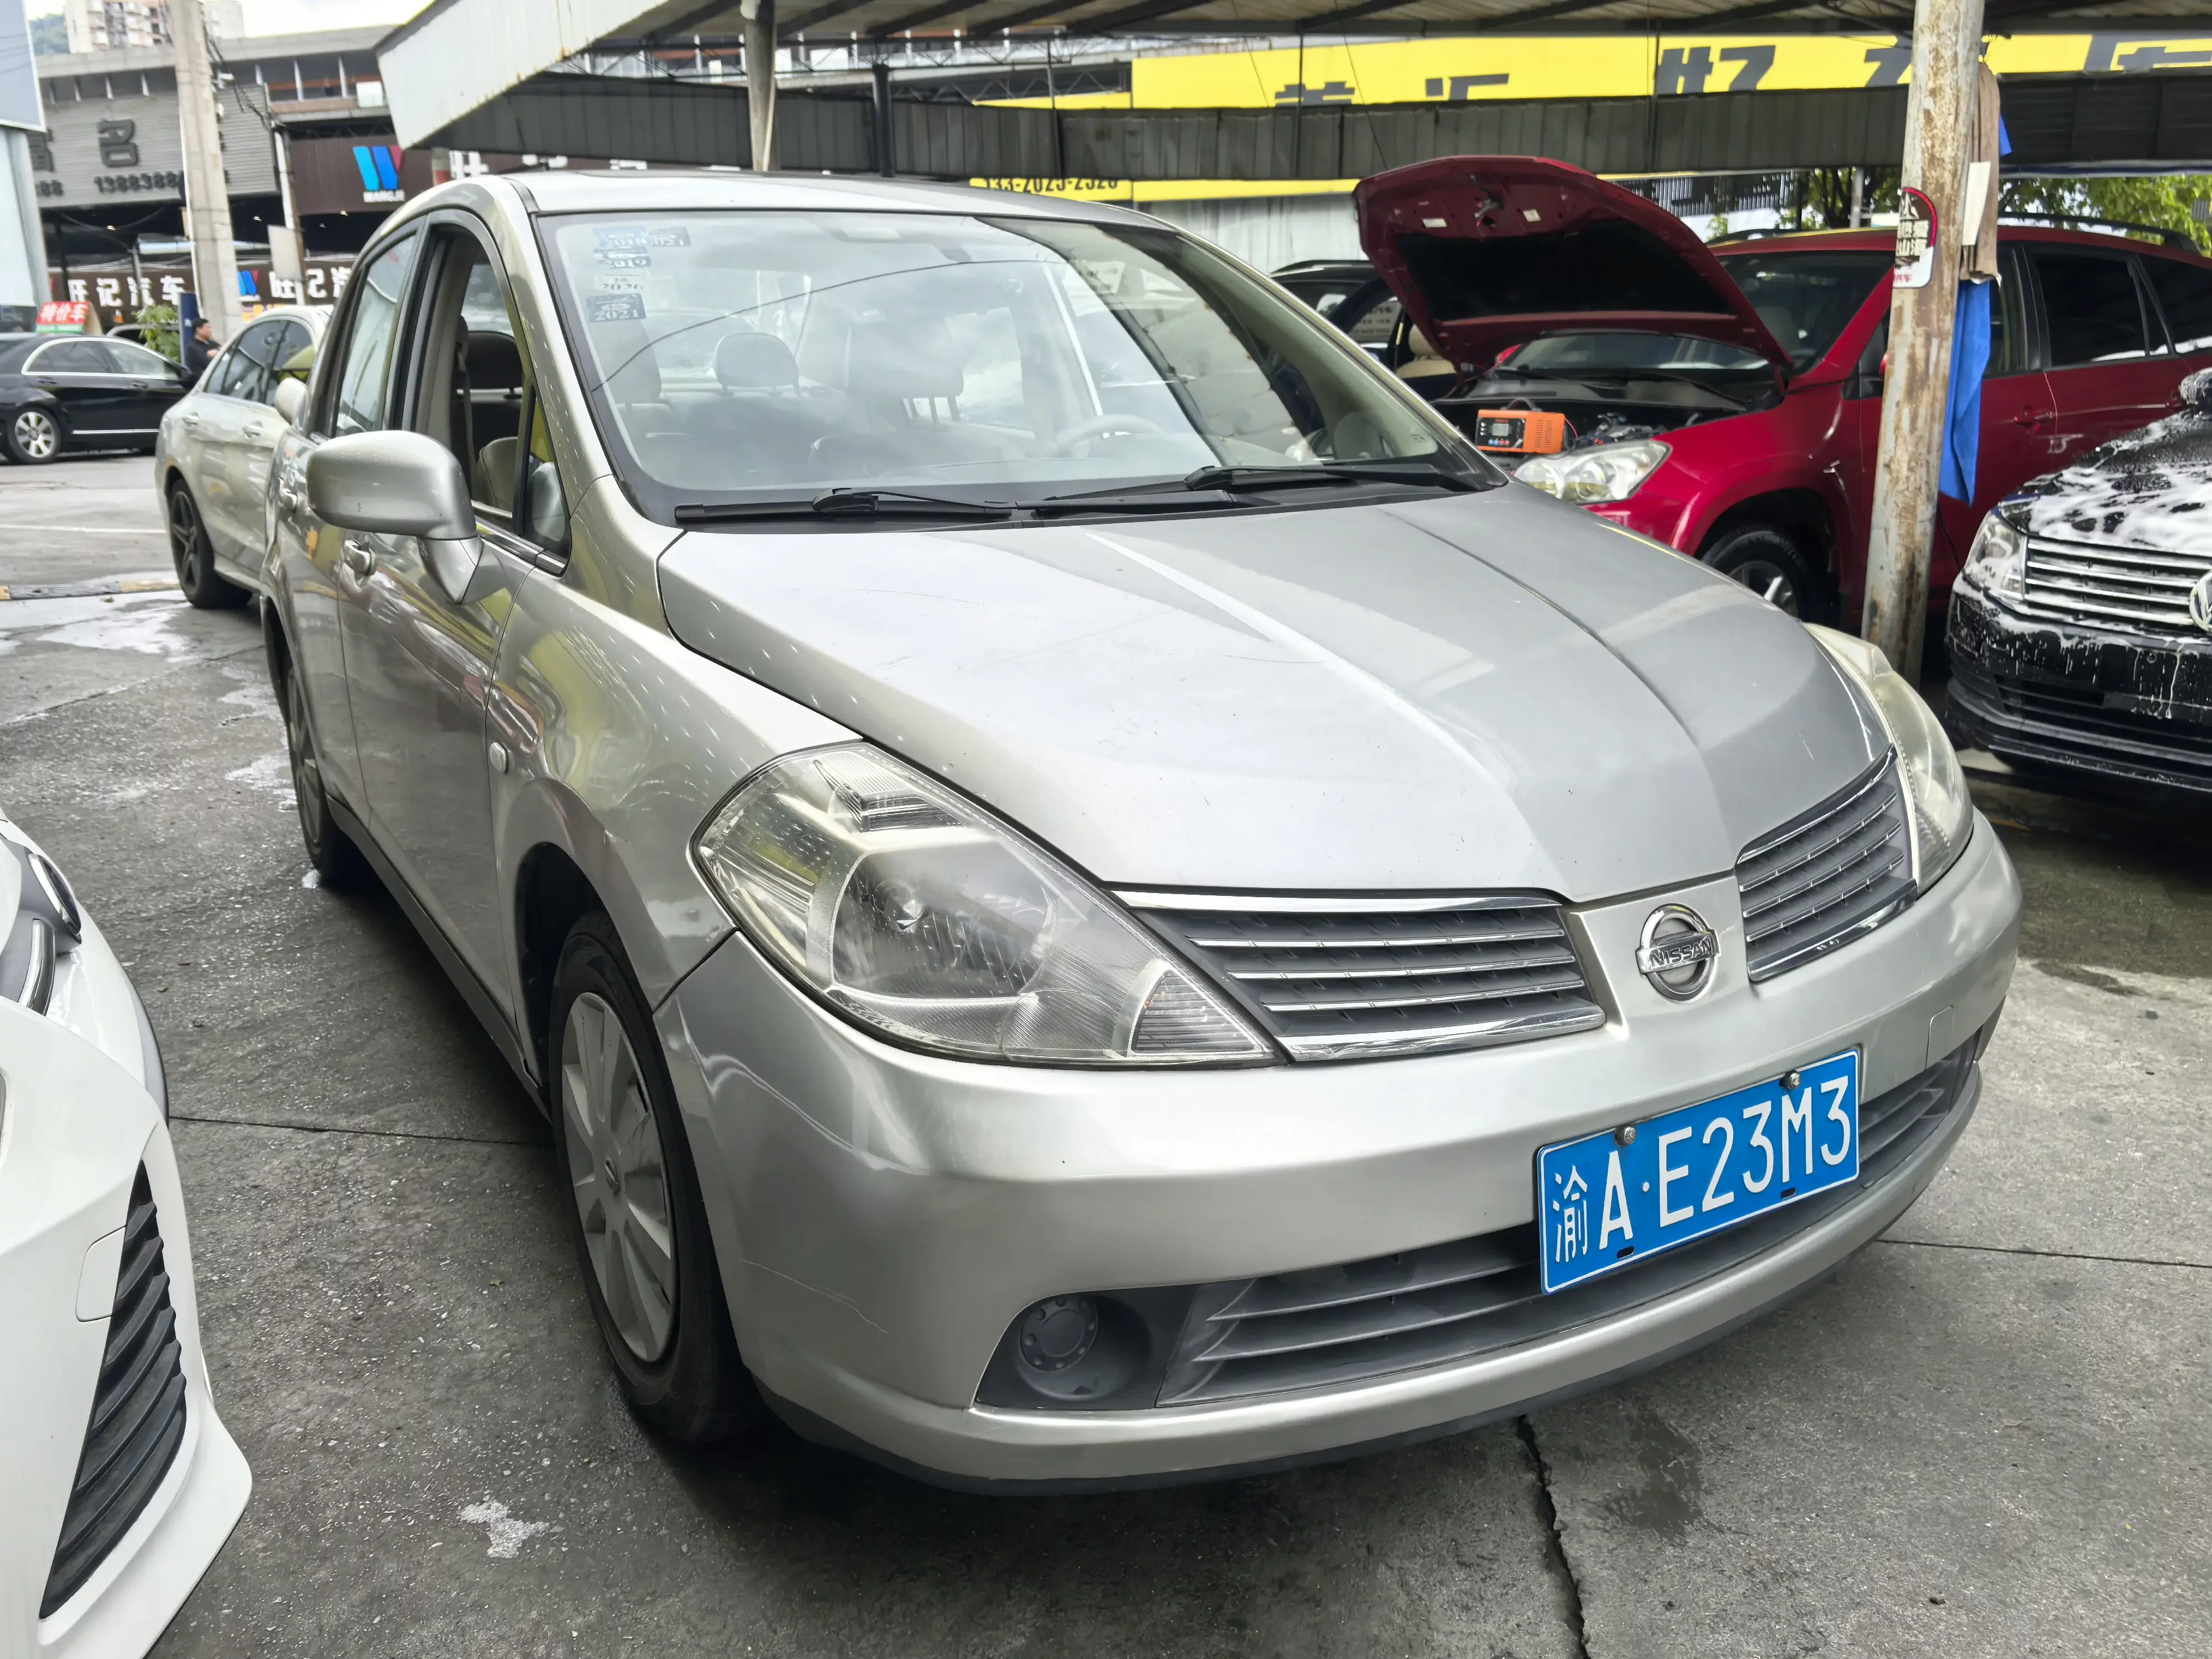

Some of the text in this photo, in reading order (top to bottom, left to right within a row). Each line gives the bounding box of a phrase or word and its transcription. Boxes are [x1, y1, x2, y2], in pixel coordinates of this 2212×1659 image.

[40, 303, 88, 322] 特价车
[1648, 938, 1713, 967] NISSAN
[1553, 1076, 1850, 1262] 渝A·E23M3
